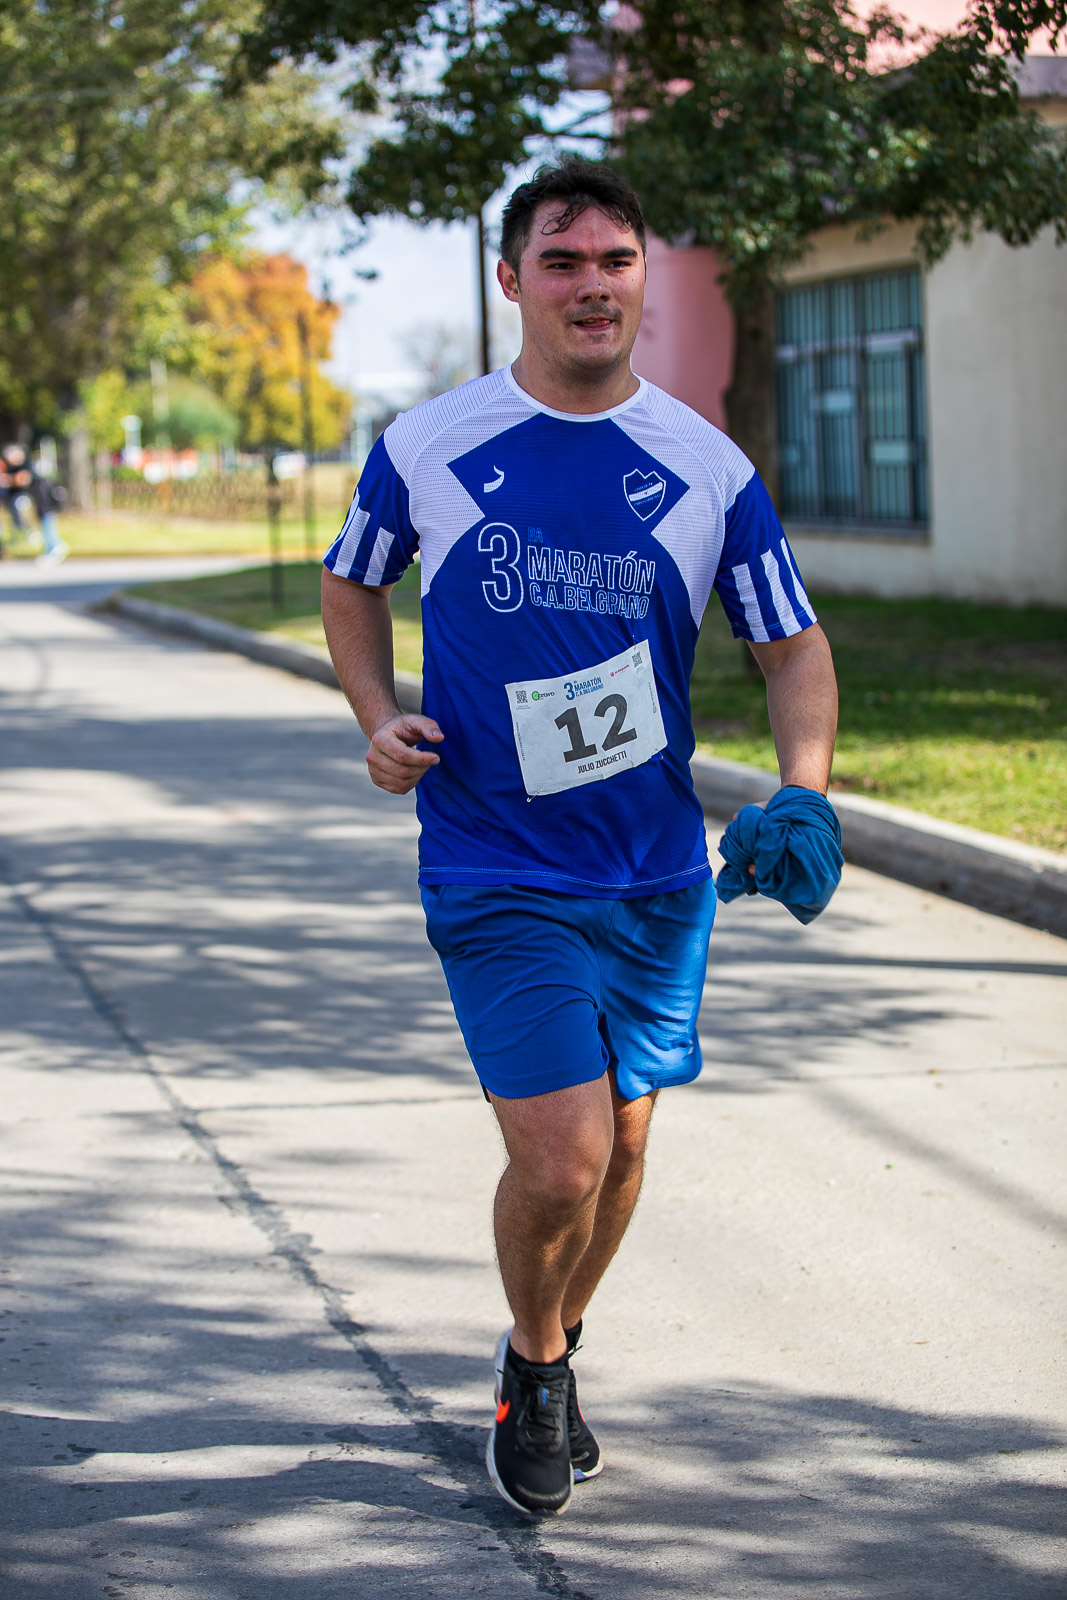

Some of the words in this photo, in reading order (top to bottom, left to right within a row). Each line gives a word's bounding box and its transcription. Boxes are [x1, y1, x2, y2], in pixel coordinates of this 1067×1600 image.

[528, 527, 543, 543] RA
[478, 522, 524, 613] 3
[527, 546, 656, 594] MARATÓN
[563, 682, 576, 701] 3
[574, 676, 602, 691] MARATÓN
[554, 694, 638, 763] 12
[578, 761, 595, 774] JULIO
[596, 750, 627, 770] ZUCCHETTI
